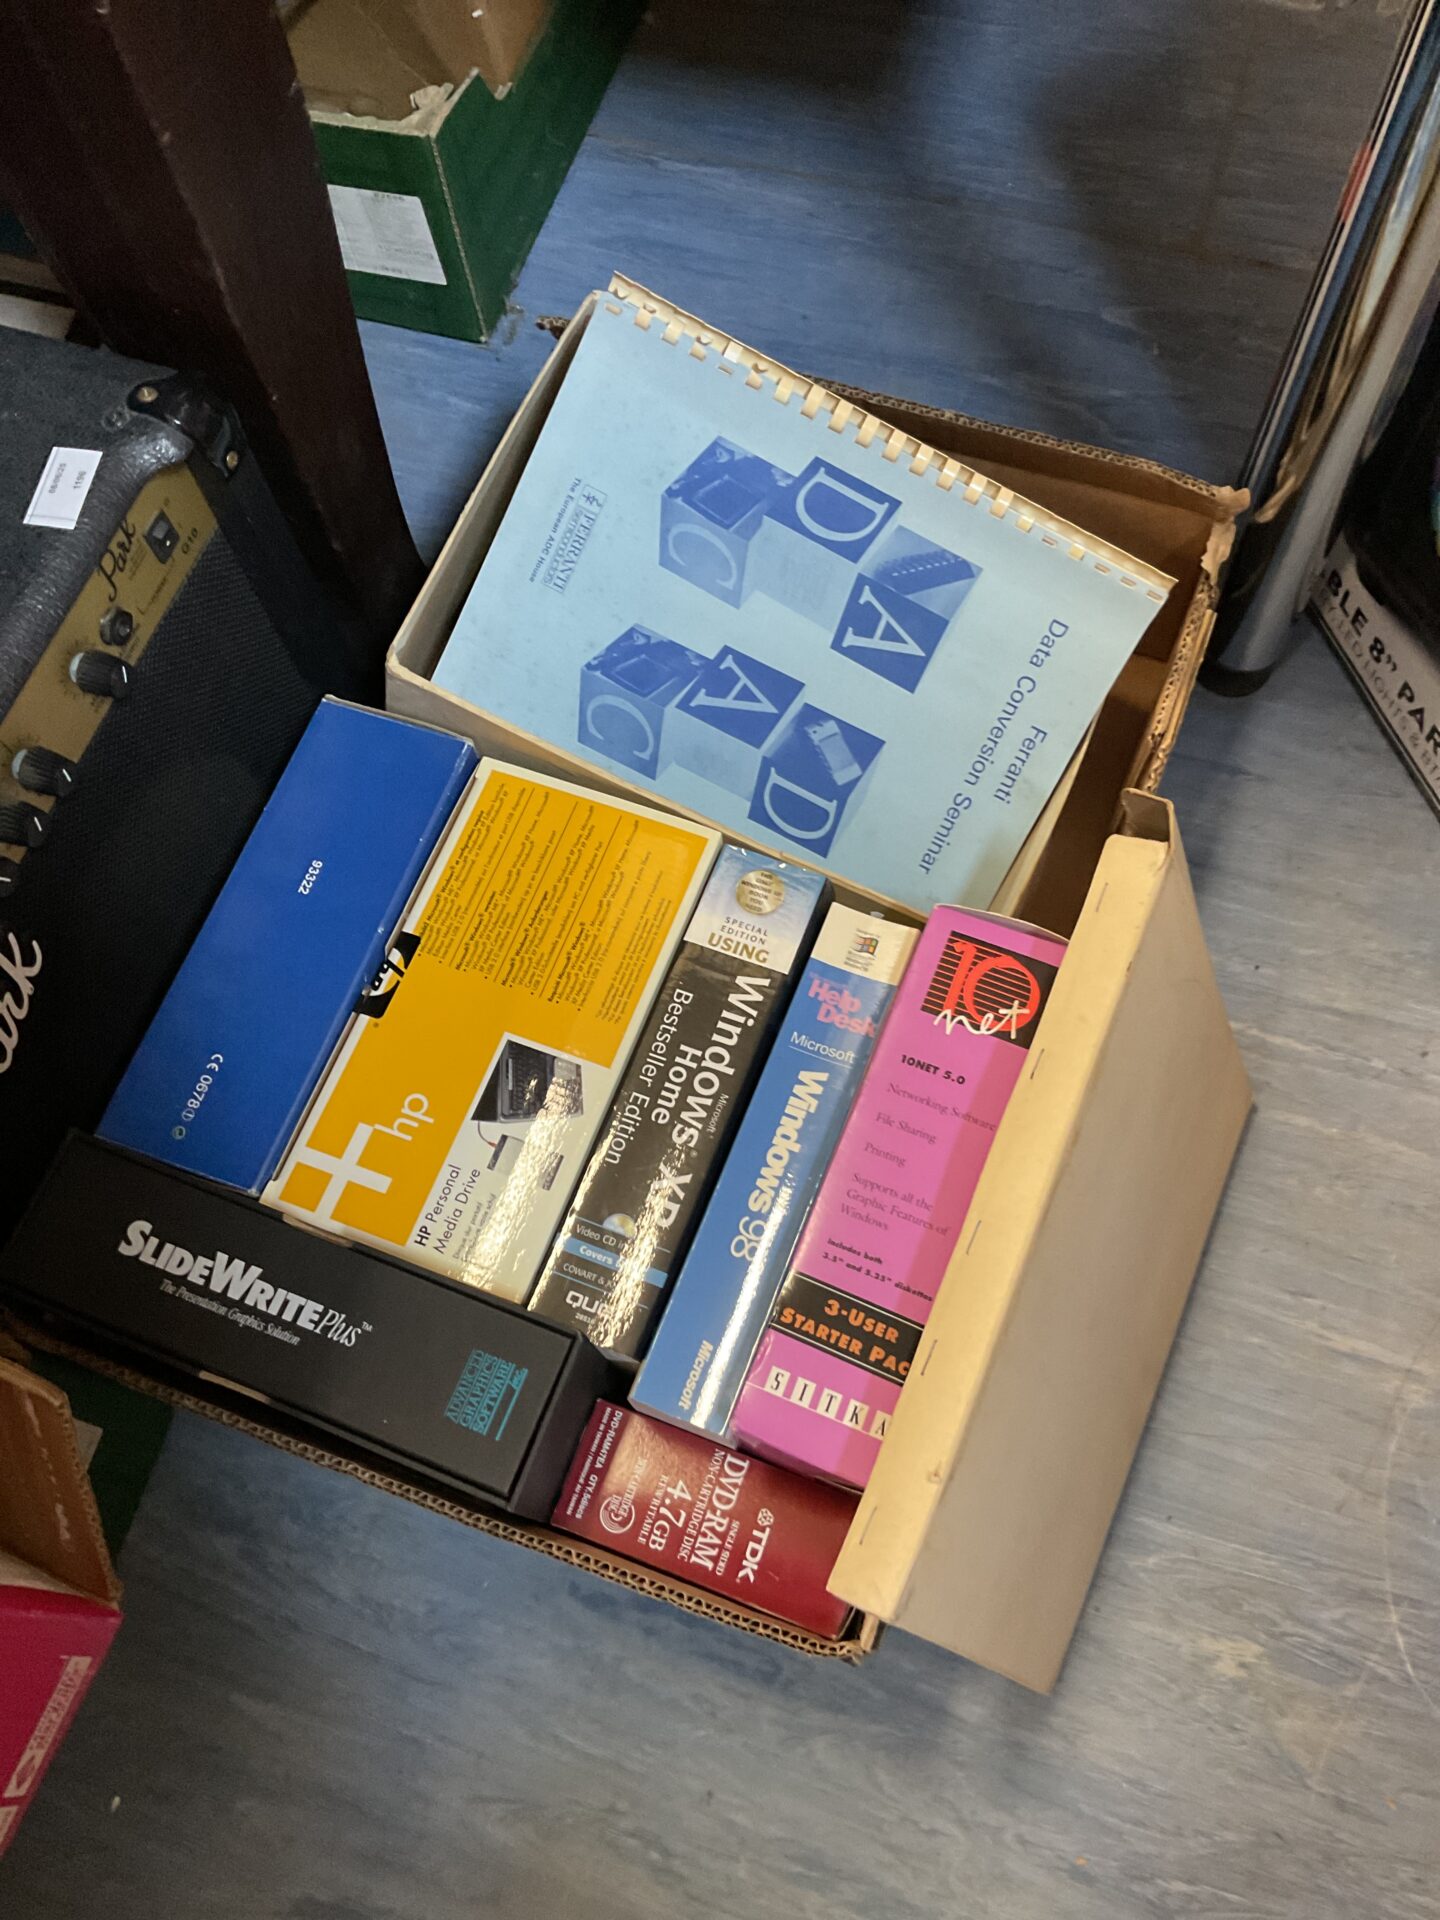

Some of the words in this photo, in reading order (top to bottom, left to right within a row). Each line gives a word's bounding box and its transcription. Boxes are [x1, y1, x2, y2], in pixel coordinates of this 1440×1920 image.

[572, 478, 581, 492] The
[552, 494, 574, 532] European
[99, 519, 135, 601] Park
[542, 535, 554, 555] ADC
[553, 513, 595, 591] FERRANTI
[529, 556, 545, 582] House
[1029, 619, 1069, 668] Data
[964, 675, 1036, 786] Conversion
[993, 725, 1048, 805] Ferranti
[919, 792, 972, 875] Seminar
[297, 859, 323, 895] 93322
[720, 924, 768, 946] EDITION
[725, 916, 769, 937] SPECIAL
[708, 933, 769, 964] USING
[808, 980, 862, 1013] Help
[637, 988, 694, 1090] Bestseller
[817, 1002, 877, 1038] Desk
[933, 999, 1031, 1040] net
[790, 1031, 857, 1064] Microsoft
[650, 1043, 703, 1125] Home
[900, 1054, 940, 1077] 10NET
[944, 1070, 966, 1087] 5.0
[187, 1074, 212, 1110] 0678
[886, 1081, 950, 1117] Networking
[950, 1104, 997, 1132] Software
[374, 1093, 434, 1141] hp
[604, 1092, 651, 1165] Edition
[876, 1111, 898, 1131] File
[900, 1118, 937, 1146] Sharing
[747, 1071, 830, 1220] Windows
[863, 1141, 907, 1169] Printing
[414, 1226, 434, 1246] HP
[425, 1163, 461, 1222] Personal
[433, 1206, 462, 1254] Media
[457, 1168, 480, 1203] Drive
[844, 1188, 888, 1212] Graphic
[888, 1204, 935, 1230] Features
[934, 1224, 950, 1237] of
[850, 1173, 900, 1199] Supports
[900, 1190, 914, 1203] all
[914, 1197, 934, 1212] the
[574, 1223, 601, 1241] Video
[601, 1233, 617, 1247] CD
[837, 1203, 891, 1231] Windows
[578, 1244, 614, 1265] Covers
[730, 1218, 770, 1265] 98
[862, 1251, 884, 1265] both
[561, 1262, 597, 1281] COWART
[845, 1262, 862, 1272] and
[893, 1280, 934, 1302] diskettes
[159, 1278, 176, 1293] The
[174, 1284, 229, 1316] Presentation
[227, 1305, 265, 1332] Graphics
[263, 1318, 301, 1346] Solution
[781, 1306, 863, 1356] STARTER
[824, 1298, 899, 1343] 3-USER
[442, 1347, 489, 1422] ADVANCED
[455, 1353, 502, 1427] GRAPHICS
[677, 1339, 713, 1411] Microsoft
[468, 1358, 516, 1434] SOFTWARE
[600, 1406, 612, 1424] MADE
[597, 1423, 606, 1431] IN
[638, 1474, 669, 1545] REWRITABLE
[685, 1448, 726, 1536] NON-CARTRIDGE
[690, 1454, 749, 1572] DVD-RAM
[678, 1538, 695, 1562] DISC
[725, 1520, 740, 1551] SINGLE
[736, 1527, 770, 1584] TDK
[715, 1550, 732, 1576] SIDED
